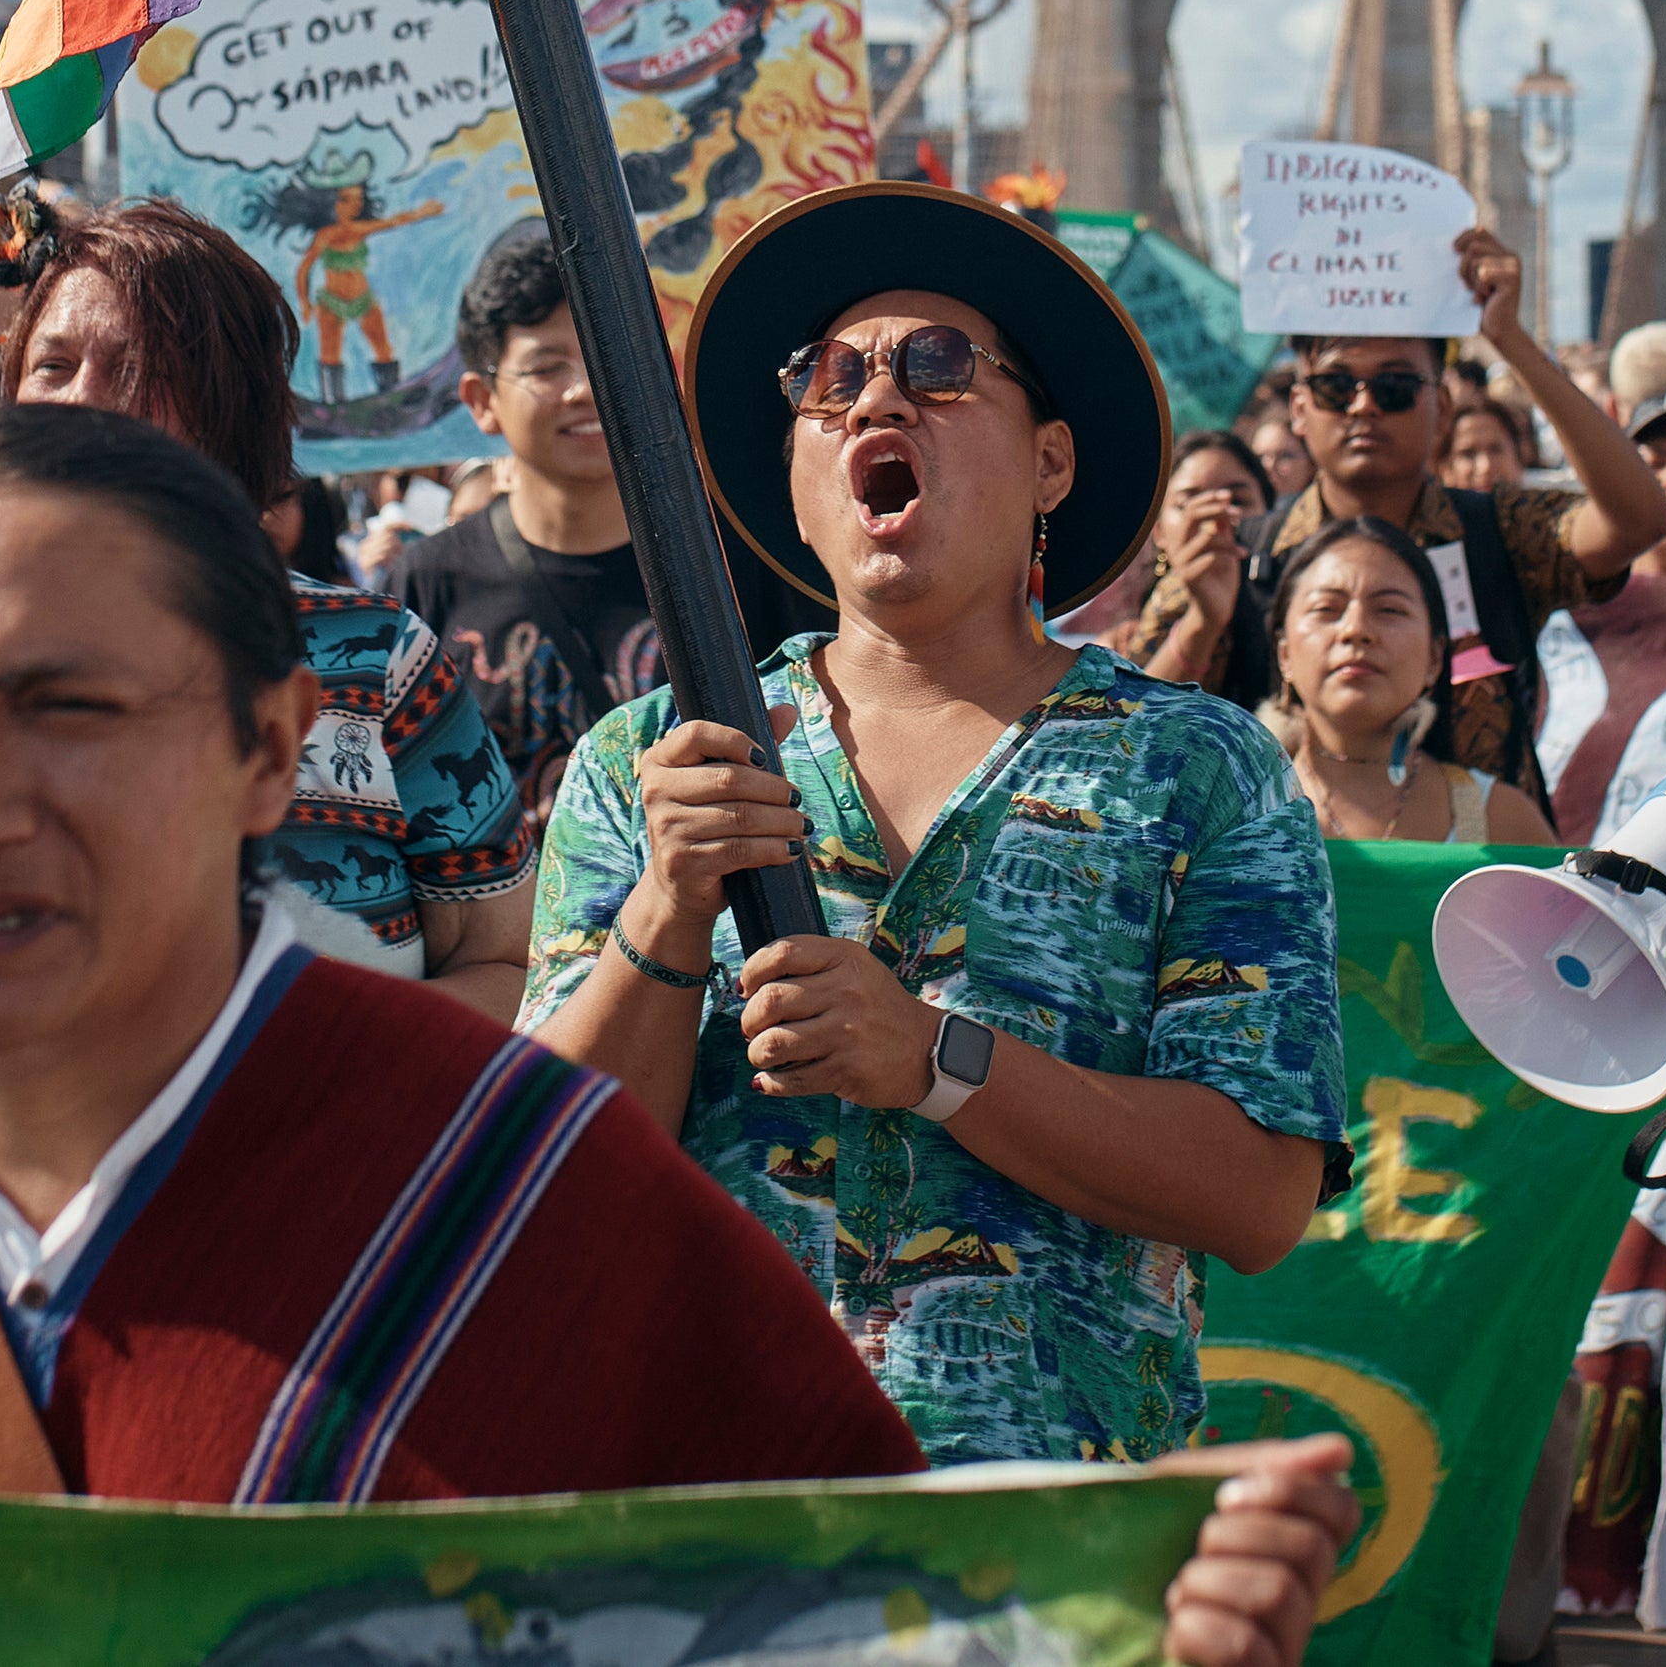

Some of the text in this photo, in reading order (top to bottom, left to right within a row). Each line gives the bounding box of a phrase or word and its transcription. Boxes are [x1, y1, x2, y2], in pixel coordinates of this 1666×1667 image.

[222, 8, 433, 67] GET OUT OF
[1267, 250, 1404, 274] CLIMATE
